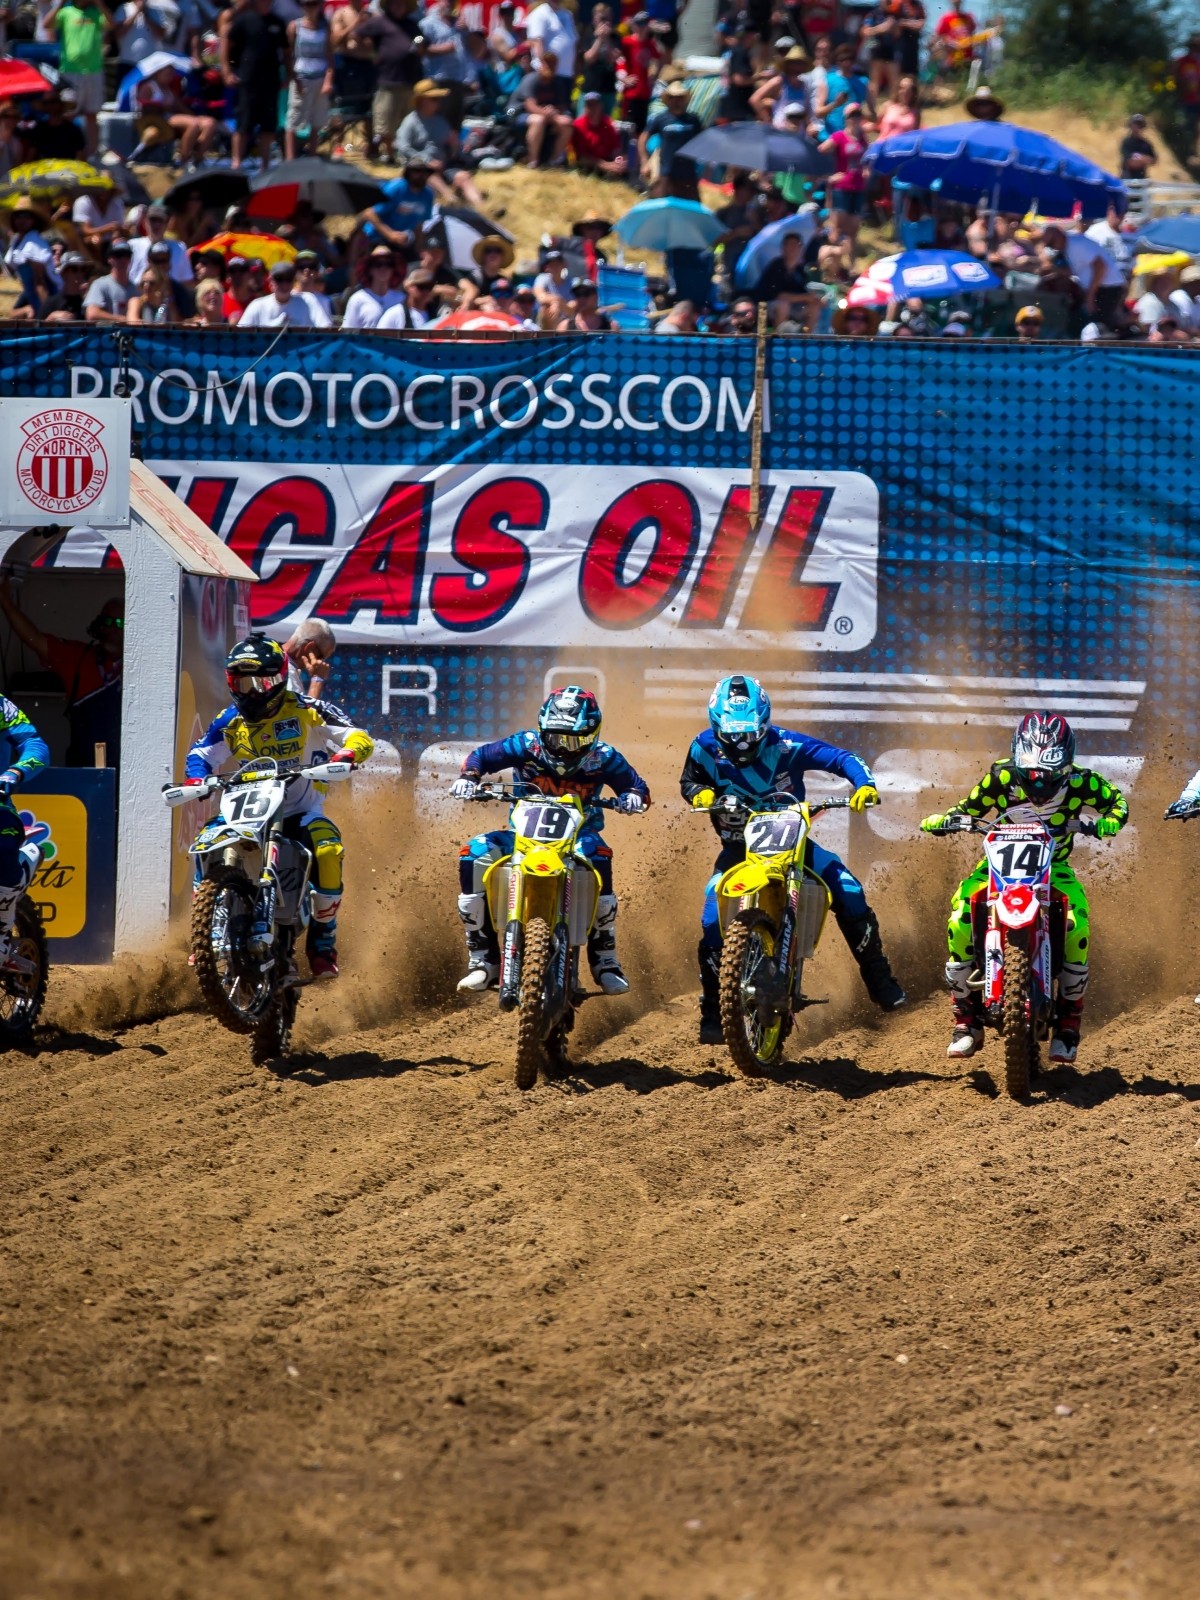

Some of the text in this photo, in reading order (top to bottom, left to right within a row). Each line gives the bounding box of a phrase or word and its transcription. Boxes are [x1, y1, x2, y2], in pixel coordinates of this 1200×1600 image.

[71, 367, 770, 433] PROMOTOCROSS.COM
[31, 412, 94, 429] MEMBER
[25, 425, 100, 453] DIRT DIGGERS
[43, 440, 82, 455] NORTH
[20, 468, 104, 510] MOTORCYCLE CLUB
[158, 475, 841, 632] CAS OIL
[230, 790, 271, 822] 15
[523, 806, 571, 839] 19
[749, 819, 801, 853] 20
[997, 843, 1042, 877] 14
[503, 932, 512, 984] DUNLOP
